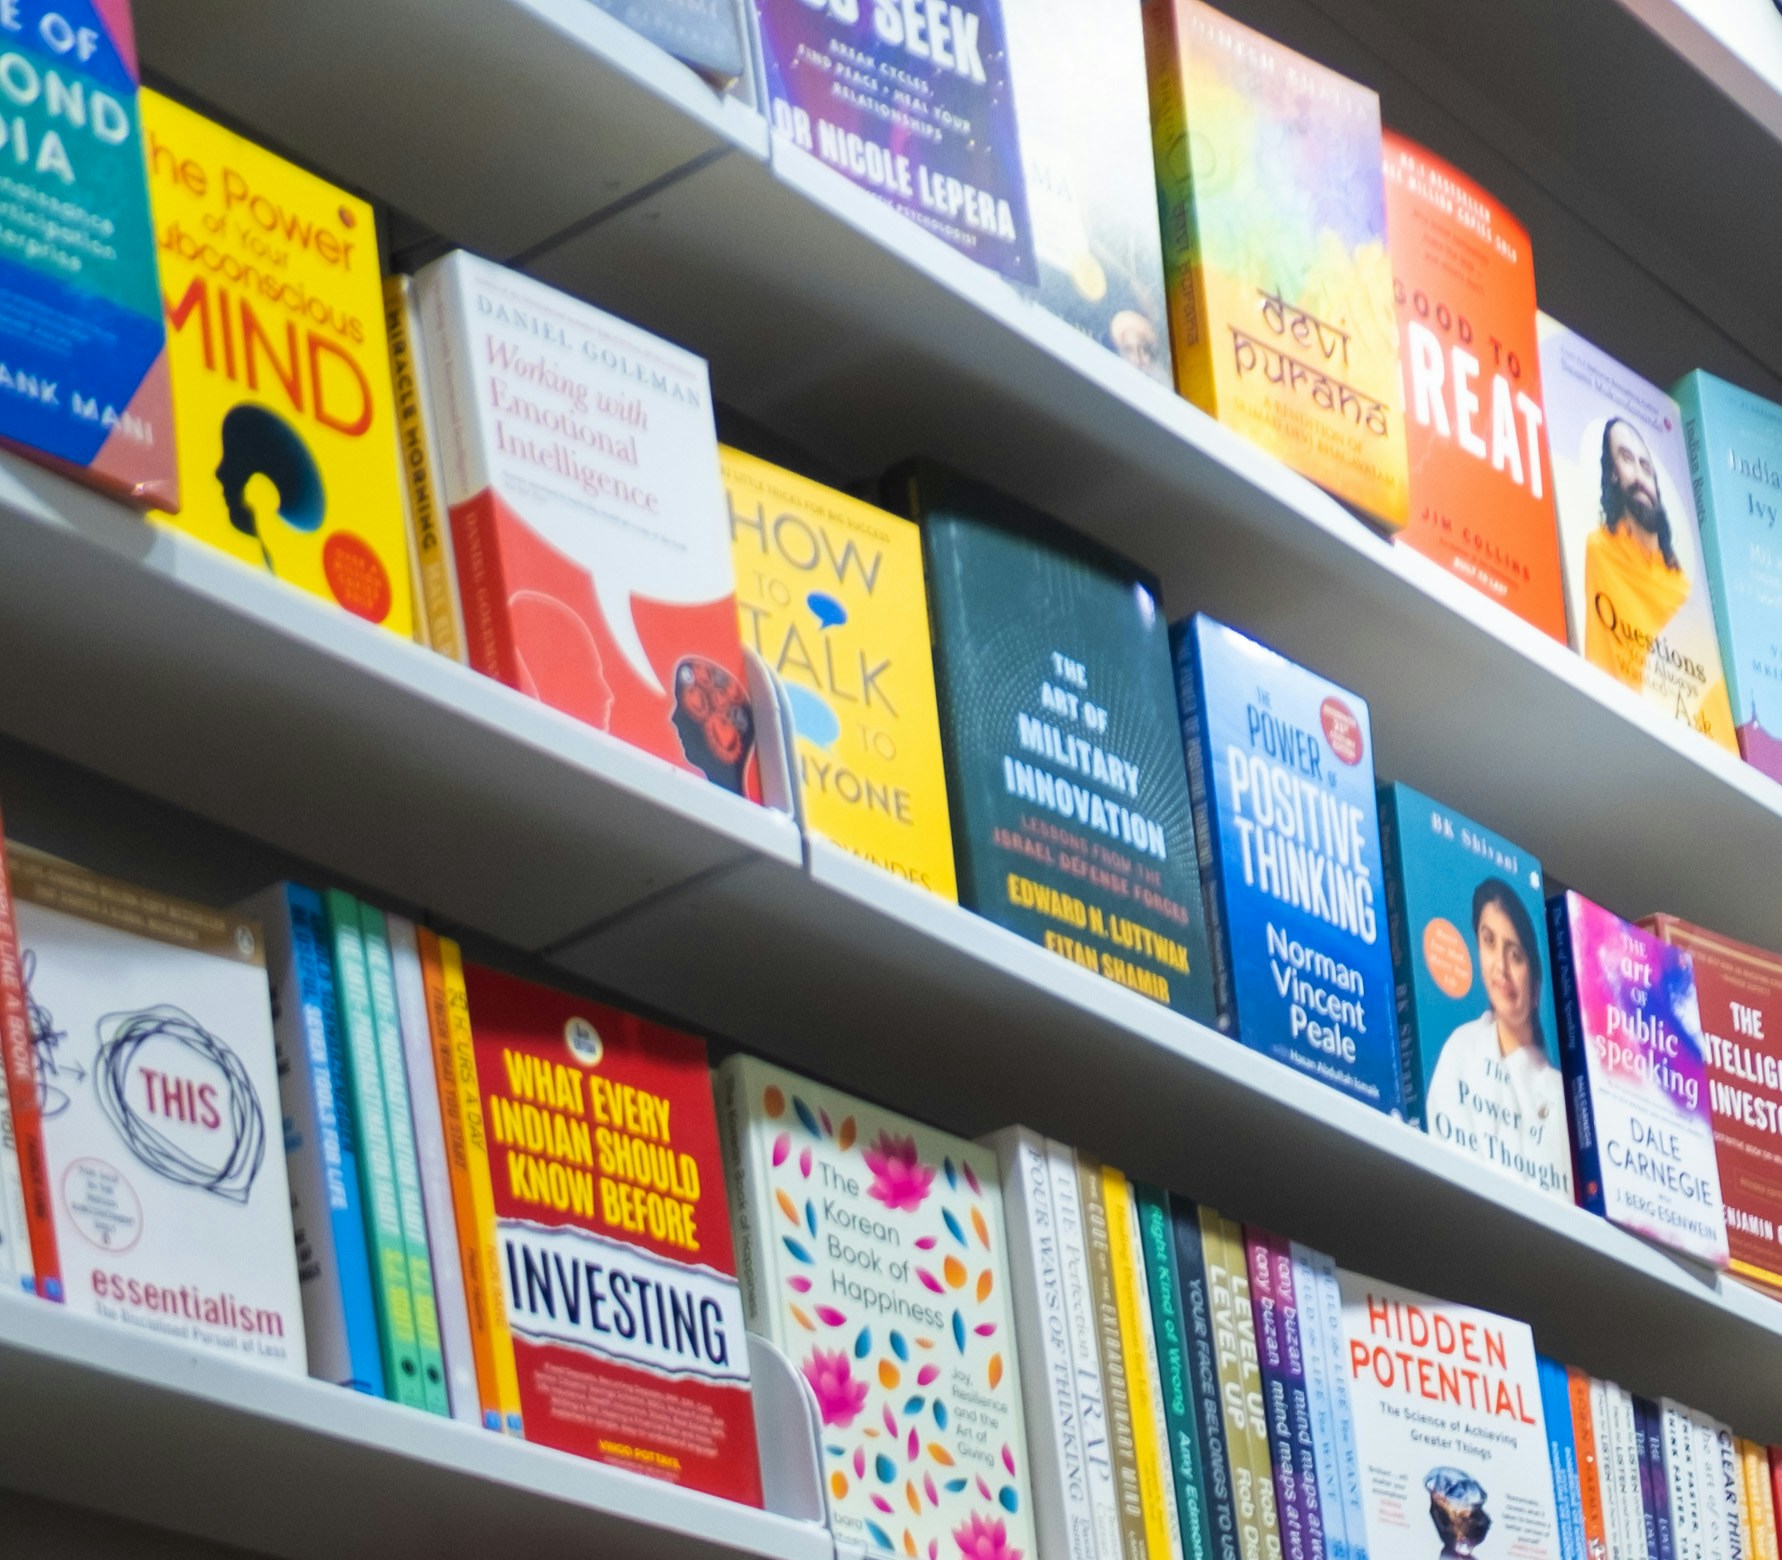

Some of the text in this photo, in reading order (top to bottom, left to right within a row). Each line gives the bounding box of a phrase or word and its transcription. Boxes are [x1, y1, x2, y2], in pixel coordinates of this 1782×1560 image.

[773, 97, 1016, 244] DR NICOLE LEPERA
[163, 278, 373, 436] MIND
[1019, 714, 1140, 799] MILITARY
[1247, 703, 1321, 782] POWER
[1004, 755, 1166, 861] INNOVATION
[1228, 745, 1368, 878] POSITIVE
[1235, 816, 1378, 944] THINKING
[138, 1066, 221, 1132] THIS
[503, 1049, 670, 1142] WHAT EVERY
[491, 1097, 700, 1201] INDIAN SHOULD
[508, 1150, 700, 1251] KNOW BEFORE
[508, 1238, 730, 1369] INVESTING
[1366, 1294, 1508, 1371] HIDDEN
[1351, 1340, 1536, 1426] POTENTIAL
